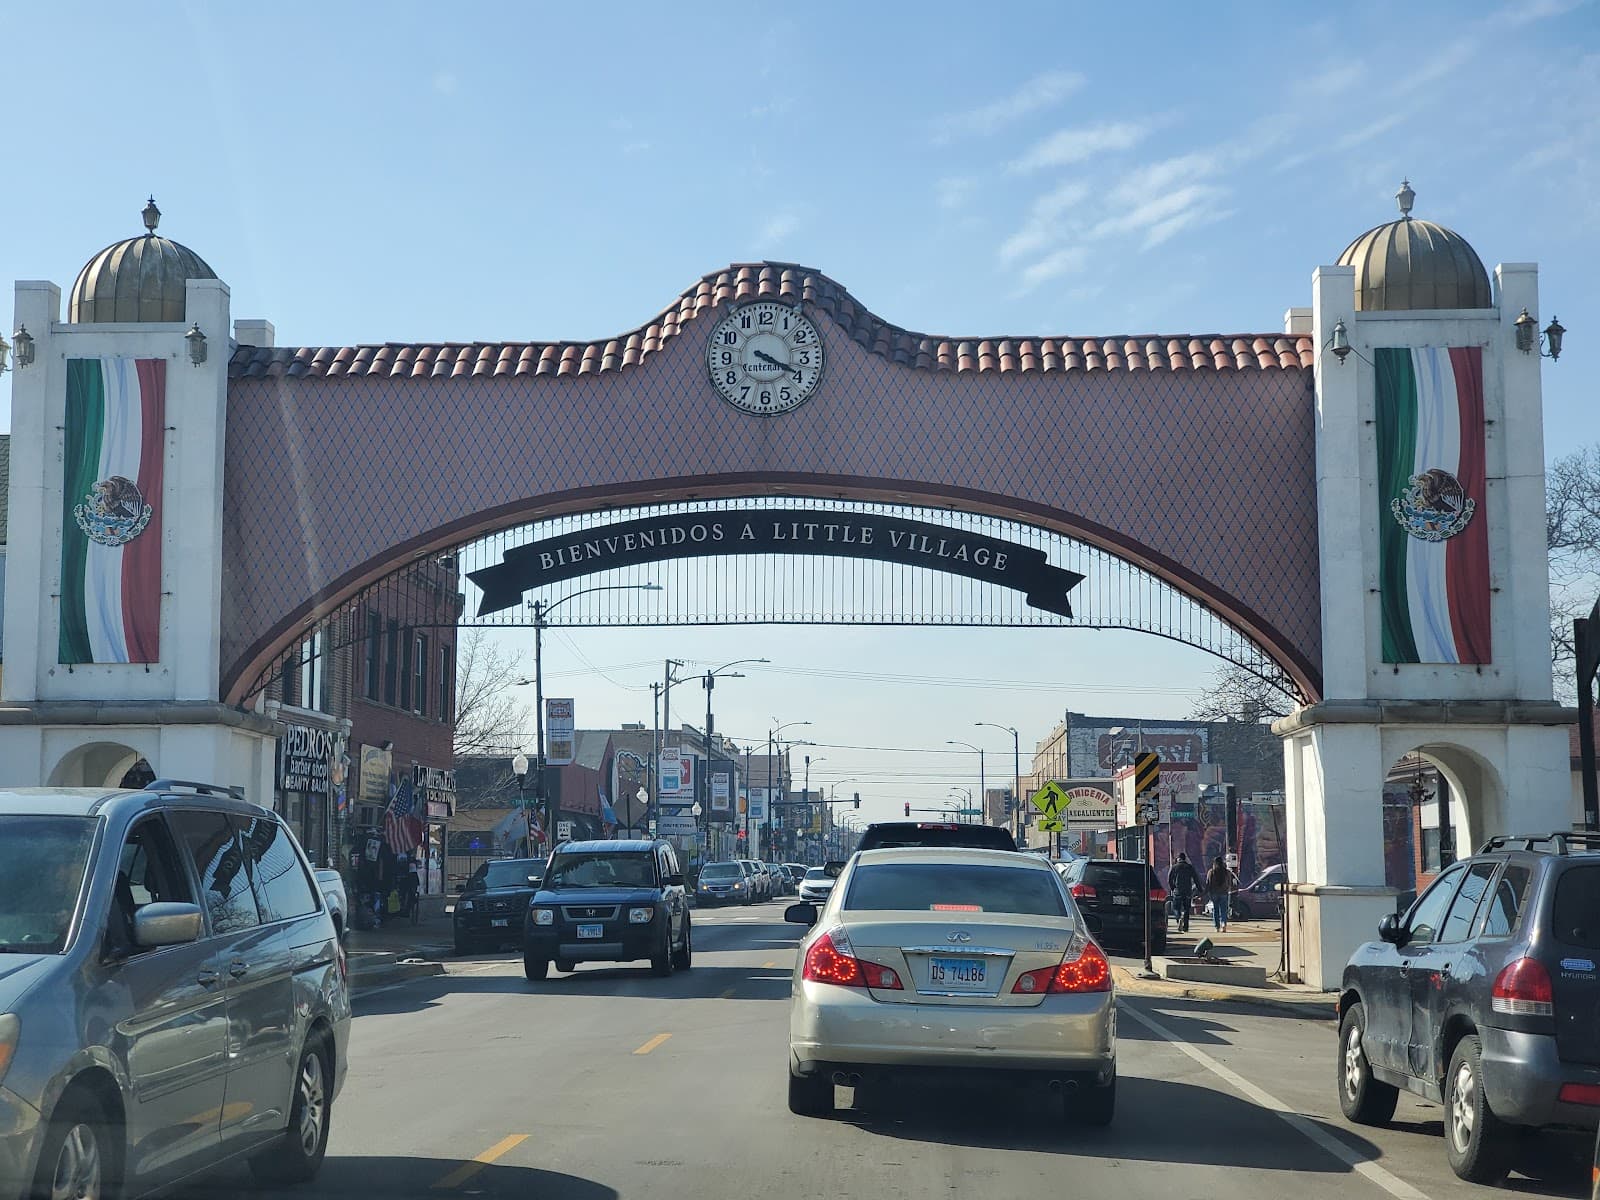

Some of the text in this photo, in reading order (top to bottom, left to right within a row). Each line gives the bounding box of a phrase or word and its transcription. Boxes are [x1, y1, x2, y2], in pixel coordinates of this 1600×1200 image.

[741, 317, 751, 328] 11
[758, 312, 773, 325] 12
[783, 317, 788, 330] 1
[724, 331, 737, 344] 10
[795, 330, 806, 344] 2
[721, 351, 732, 365] 9
[799, 351, 810, 364] 3
[726, 371, 737, 385] 8
[792, 370, 803, 383] 4
[741, 386, 751, 400] 7
[760, 391, 771, 405] 6
[779, 387, 790, 400] 5
[539, 522, 1008, 571] BIENVENIDOS A LITTLE VILLAGE
[286, 724, 333, 760] PEDRO'S
[290, 756, 327, 780] barber shop
[285, 775, 328, 792] BEAUTY SALO
[932, 965, 985, 982] DS 74186
[1560, 972, 1597, 980] HYUNDAI
